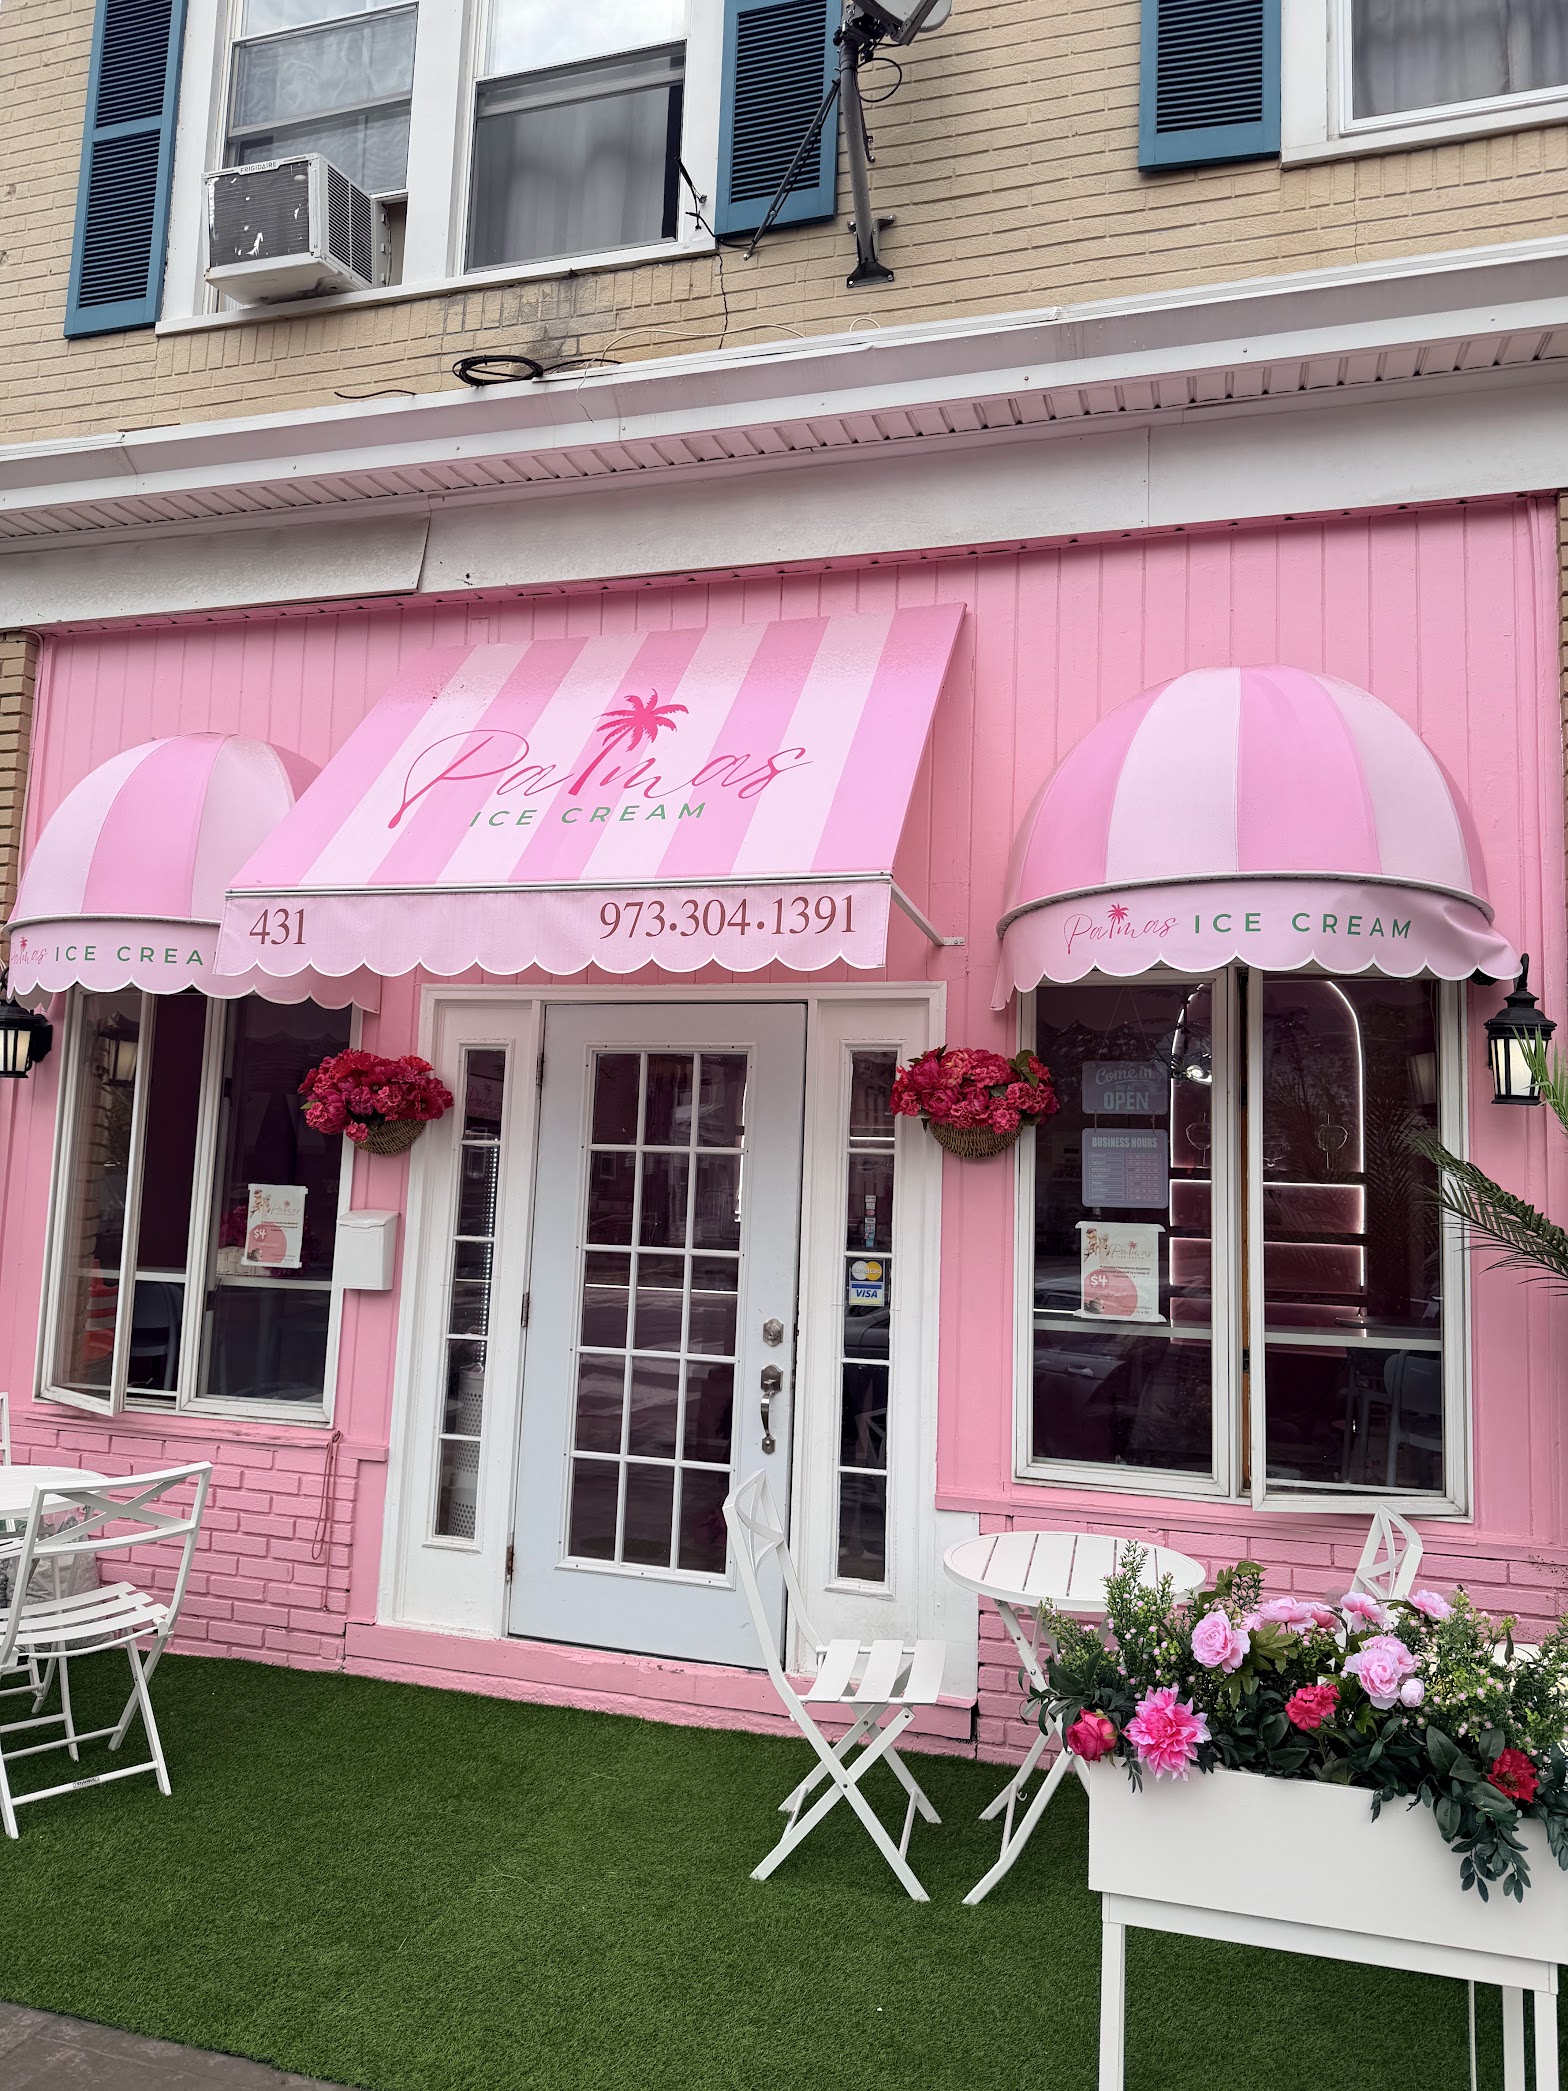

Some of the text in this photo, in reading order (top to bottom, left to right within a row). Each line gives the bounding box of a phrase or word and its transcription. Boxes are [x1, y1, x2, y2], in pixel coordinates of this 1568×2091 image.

[240, 161, 277, 173] FRIGIDAIRE
[388, 688, 814, 829] Palmas
[469, 803, 706, 828] ICE CREAM
[249, 908, 306, 944] 431
[1064, 902, 1412, 954] Palmas ICE CREAM
[56, 946, 96, 961] ICE
[116, 946, 215, 965] CREA
[1096, 1066, 1155, 1085] Come in
[1103, 1091, 1149, 1110] OPEN
[1092, 1136, 1158, 1148] BUSINESS HOURS
[253, 1228, 267, 1240] $4
[1090, 1273, 1109, 1288] $4
[856, 1289, 878, 1298] VISA
